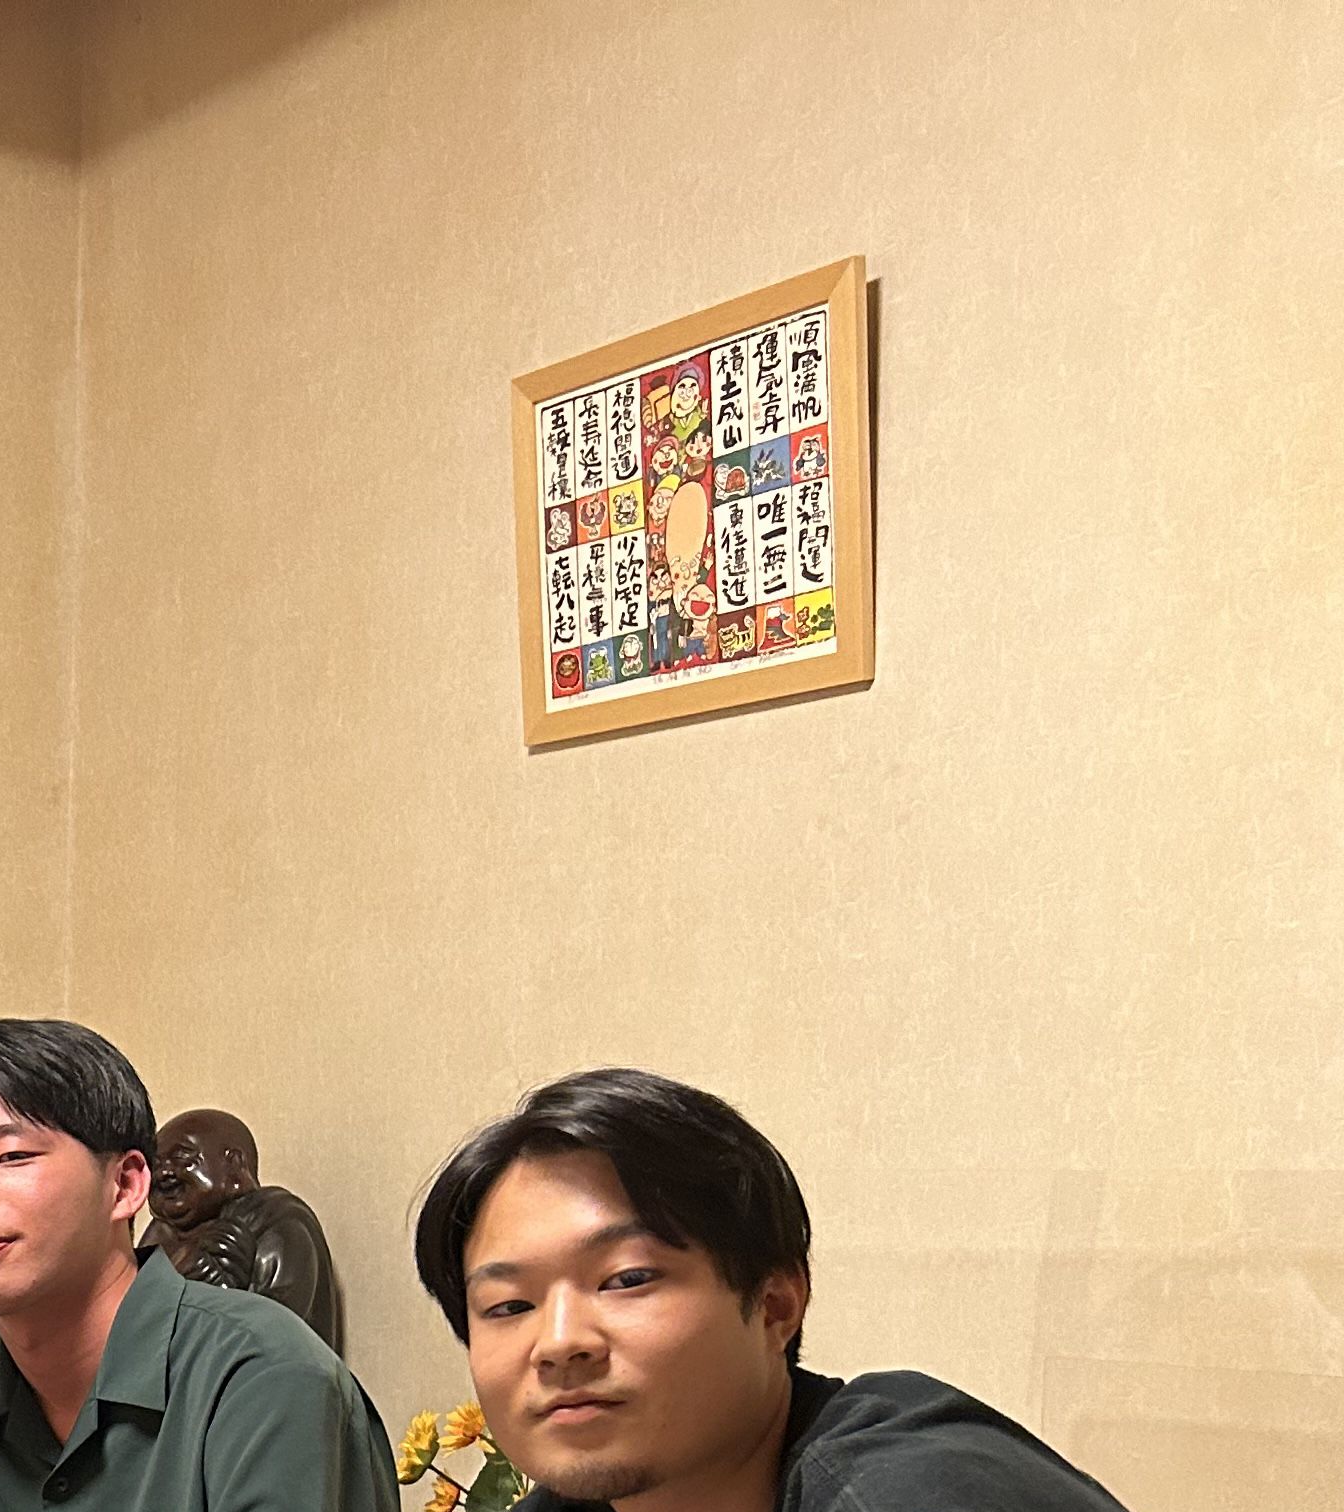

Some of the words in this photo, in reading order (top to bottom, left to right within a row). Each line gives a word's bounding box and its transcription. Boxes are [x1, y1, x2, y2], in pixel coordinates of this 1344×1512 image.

[716, 345, 745, 449] 積土成山
[752, 331, 785, 435] 運気上昇
[789, 320, 822, 424] 順風満帆
[578, 396, 604, 489] 長寿延命
[614, 535, 645, 631] 少欲知足
[720, 503, 750, 607] 勇往邁進
[757, 492, 788, 595] 唯一無二
[796, 481, 830, 583] 招福開運
[551, 556, 576, 645] 七転八起
